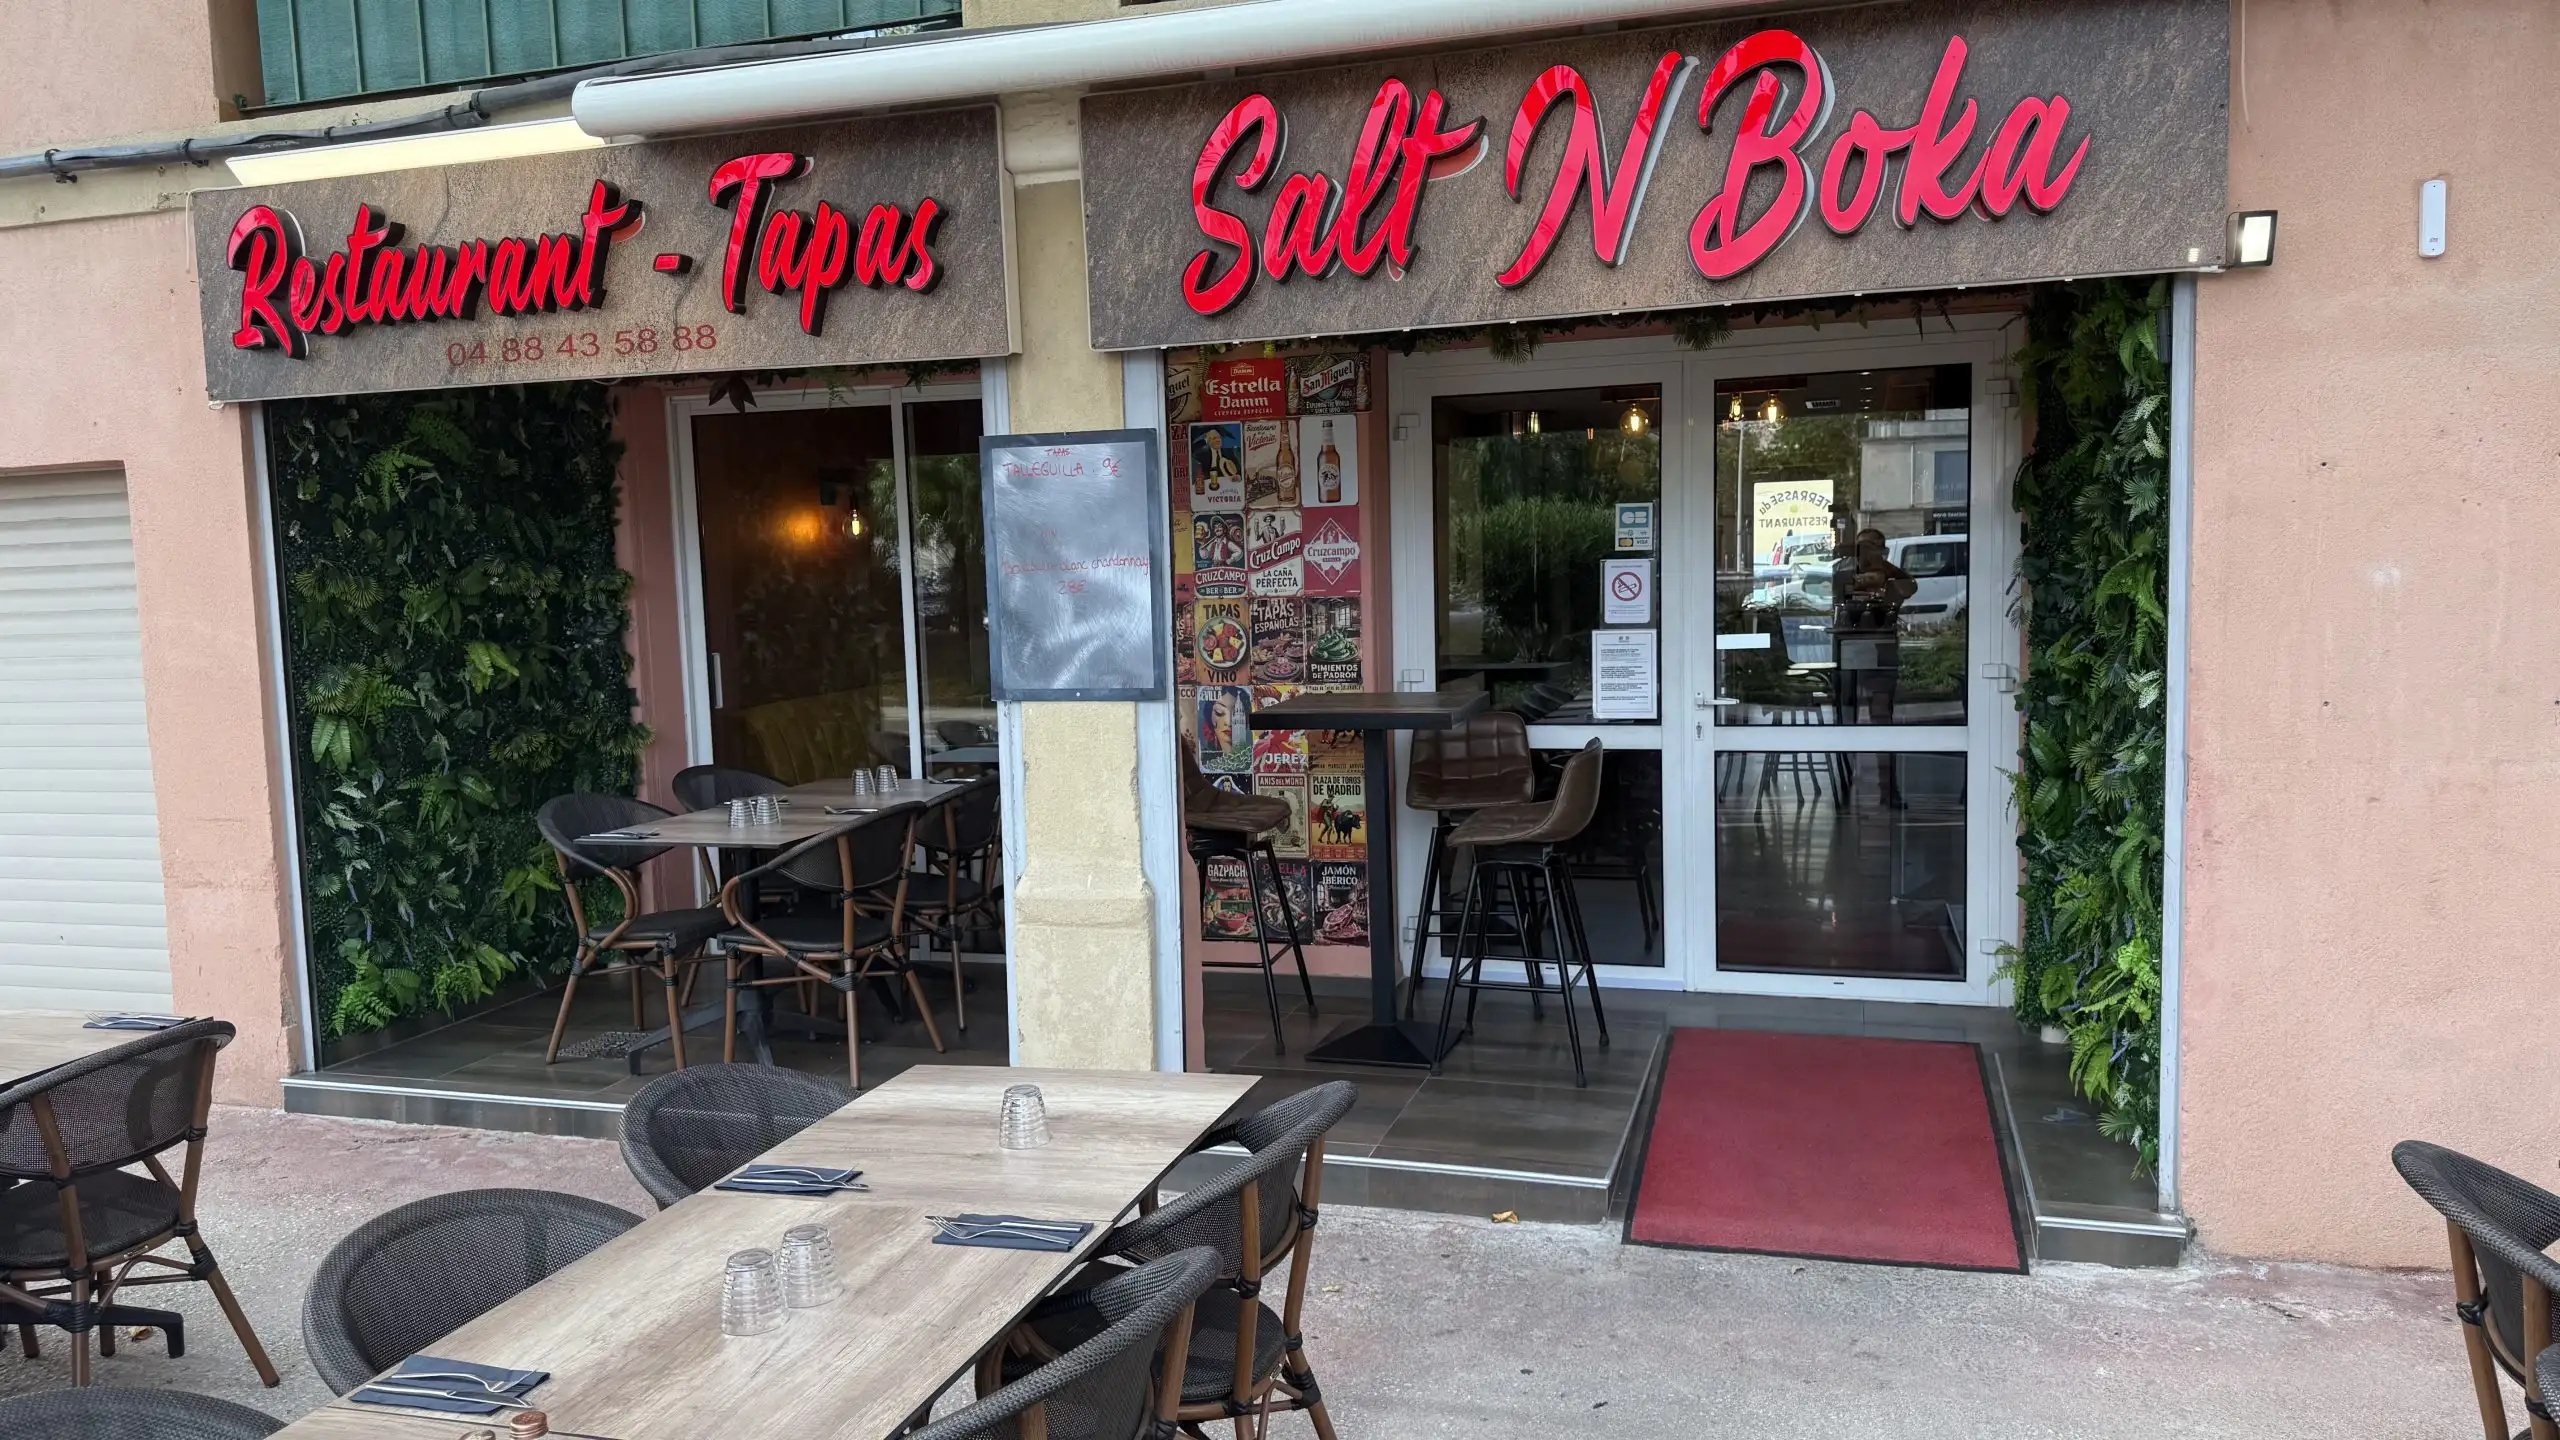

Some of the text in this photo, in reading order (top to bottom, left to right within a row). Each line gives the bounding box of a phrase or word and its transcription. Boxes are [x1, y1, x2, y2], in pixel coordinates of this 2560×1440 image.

[1182, 28, 2091, 317] Salt N Boka
[226, 177, 642, 360] Restaurant
[708, 151, 948, 338] Tapas
[447, 323, 717, 366] 04 88 43 58 88
[1205, 376, 1282, 395] Estrella
[1219, 396, 1269, 408] Damm
[1306, 547, 1356, 558] Cruzcampo
[1195, 569, 1247, 585] CRUZCAMPO
[1273, 567, 1293, 577] CAÑA
[1256, 577, 1299, 589] PERFECTA
[1203, 604, 1241, 620] TAPAS
[1257, 602, 1295, 622] TAPAS
[1311, 663, 1359, 673] PIMIENTOS
[1207, 670, 1238, 684] VINO
[1264, 752, 1308, 765] JEREZ
[1312, 776, 1333, 784] PLAZA
[1342, 776, 1361, 784] TOROS
[1313, 784, 1361, 796] DE MADRID
[1207, 863, 1248, 878] GAZPACH
[1261, 863, 1308, 877] PELLA
[1321, 863, 1357, 876] JAMÓN
[1321, 876, 1358, 886] IBÉRICO
